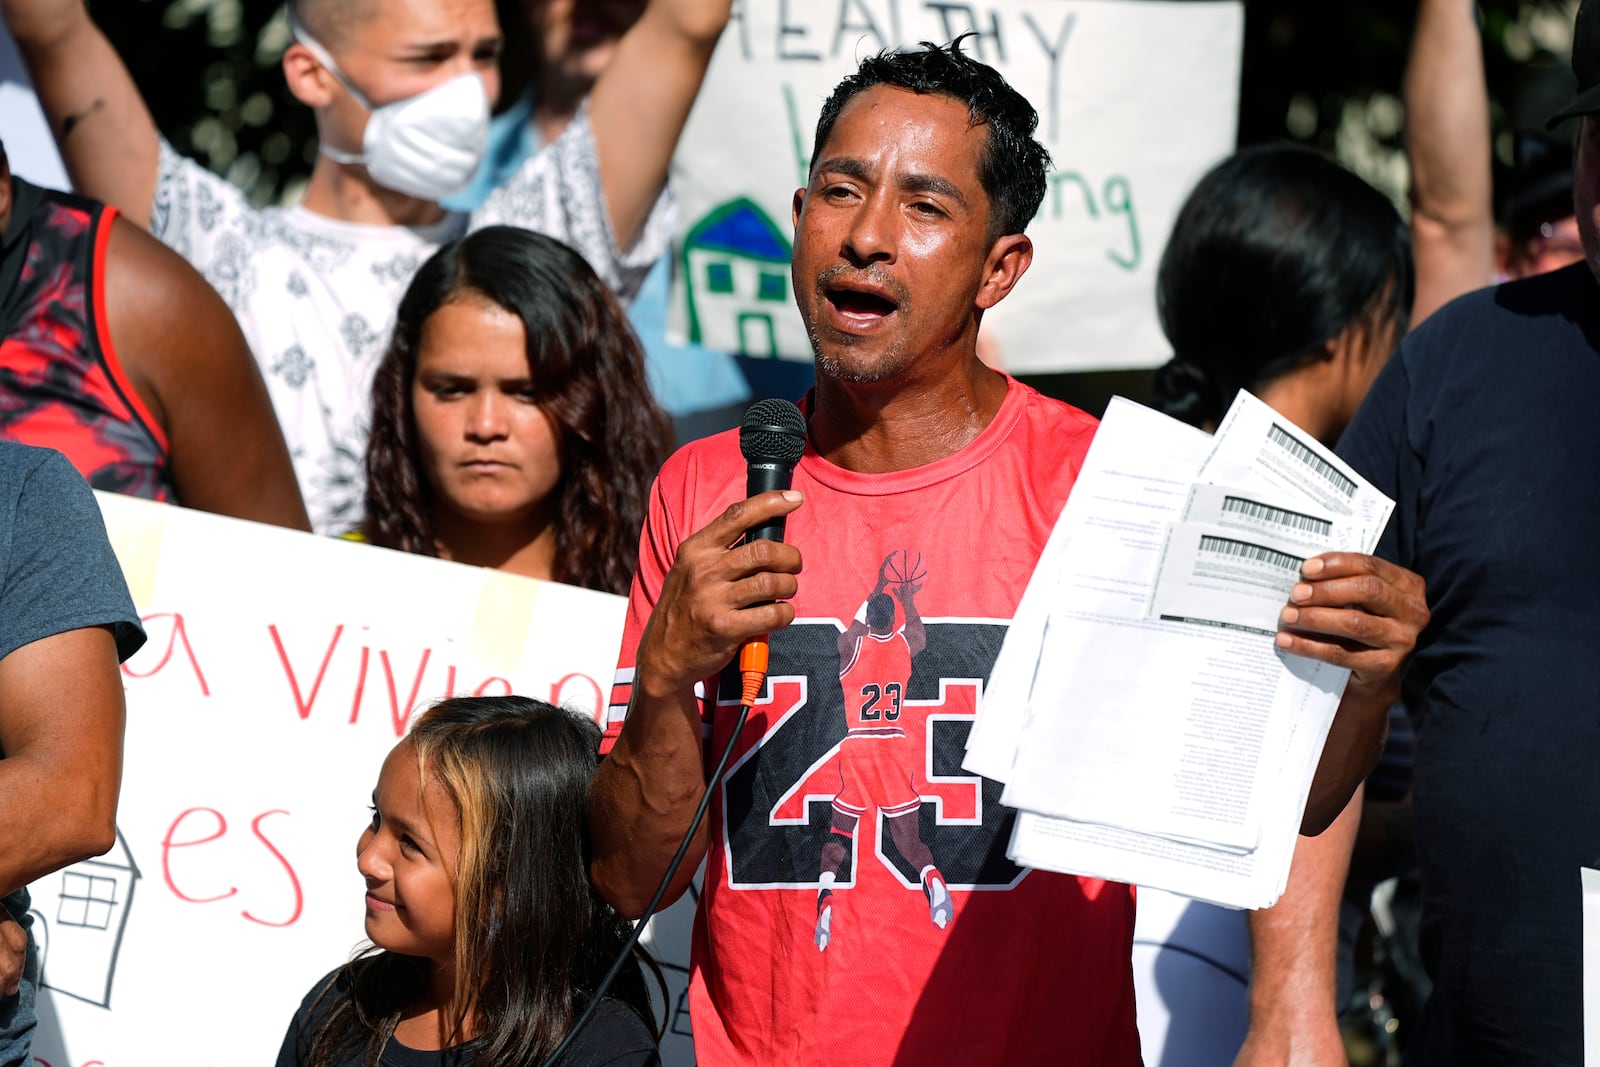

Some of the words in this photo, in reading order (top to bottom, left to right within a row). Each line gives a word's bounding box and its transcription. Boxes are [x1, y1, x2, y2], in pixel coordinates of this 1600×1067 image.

[120, 612, 211, 698] a
[860, 682, 903, 722] 23
[160, 806, 304, 918] es
